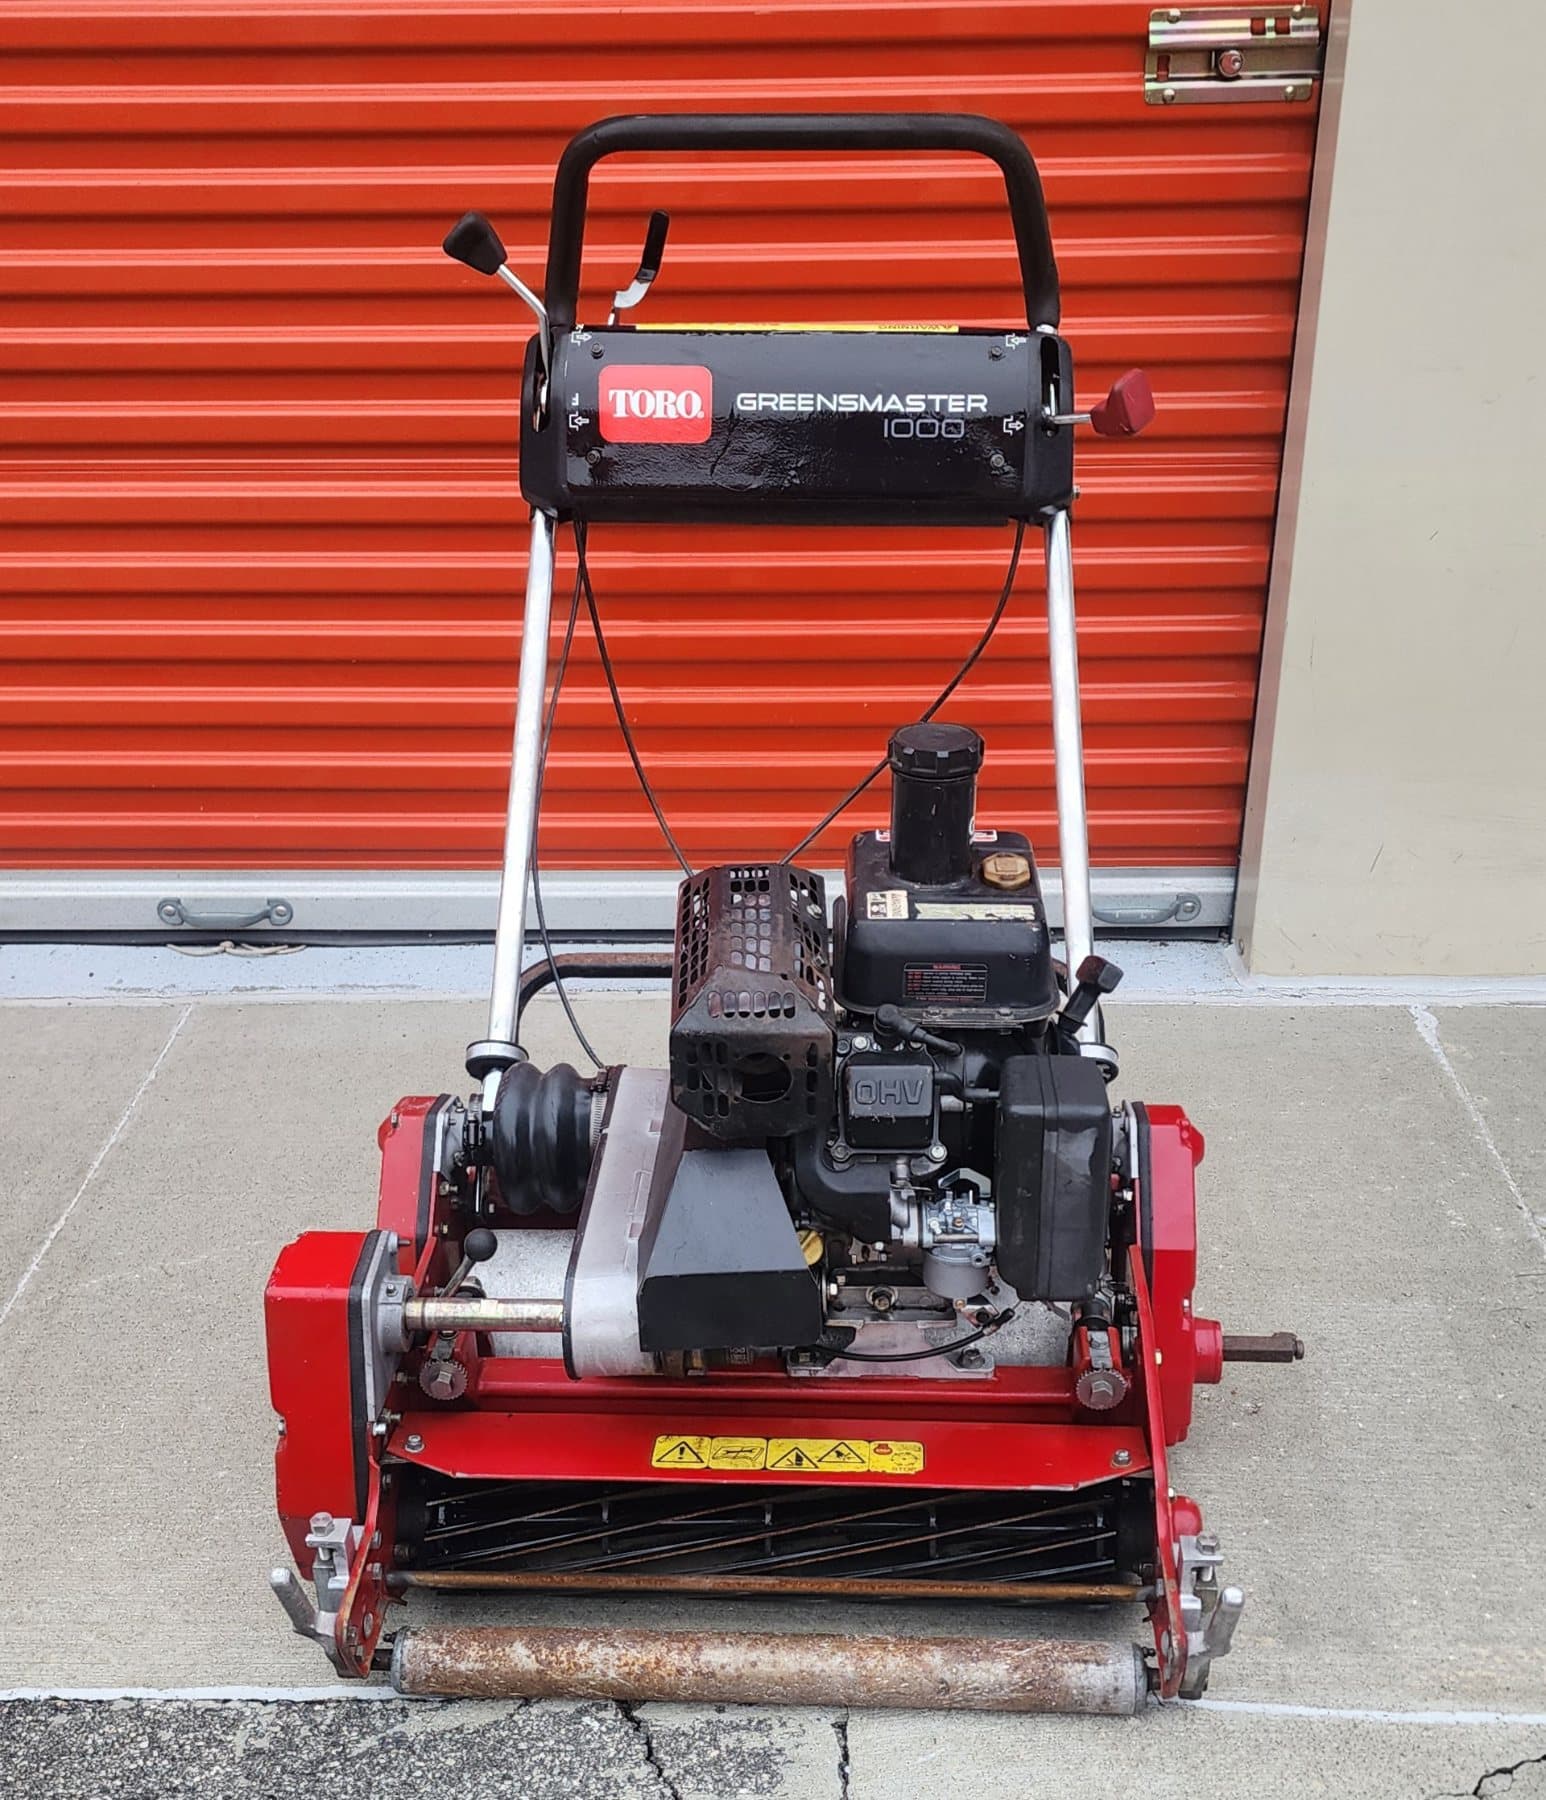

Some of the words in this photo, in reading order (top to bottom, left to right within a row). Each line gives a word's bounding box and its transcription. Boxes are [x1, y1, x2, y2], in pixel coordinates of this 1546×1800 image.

[736, 393, 989, 413] GREENSMASTER
[884, 418, 965, 438] 1000
[855, 1080, 924, 1105] OHV
